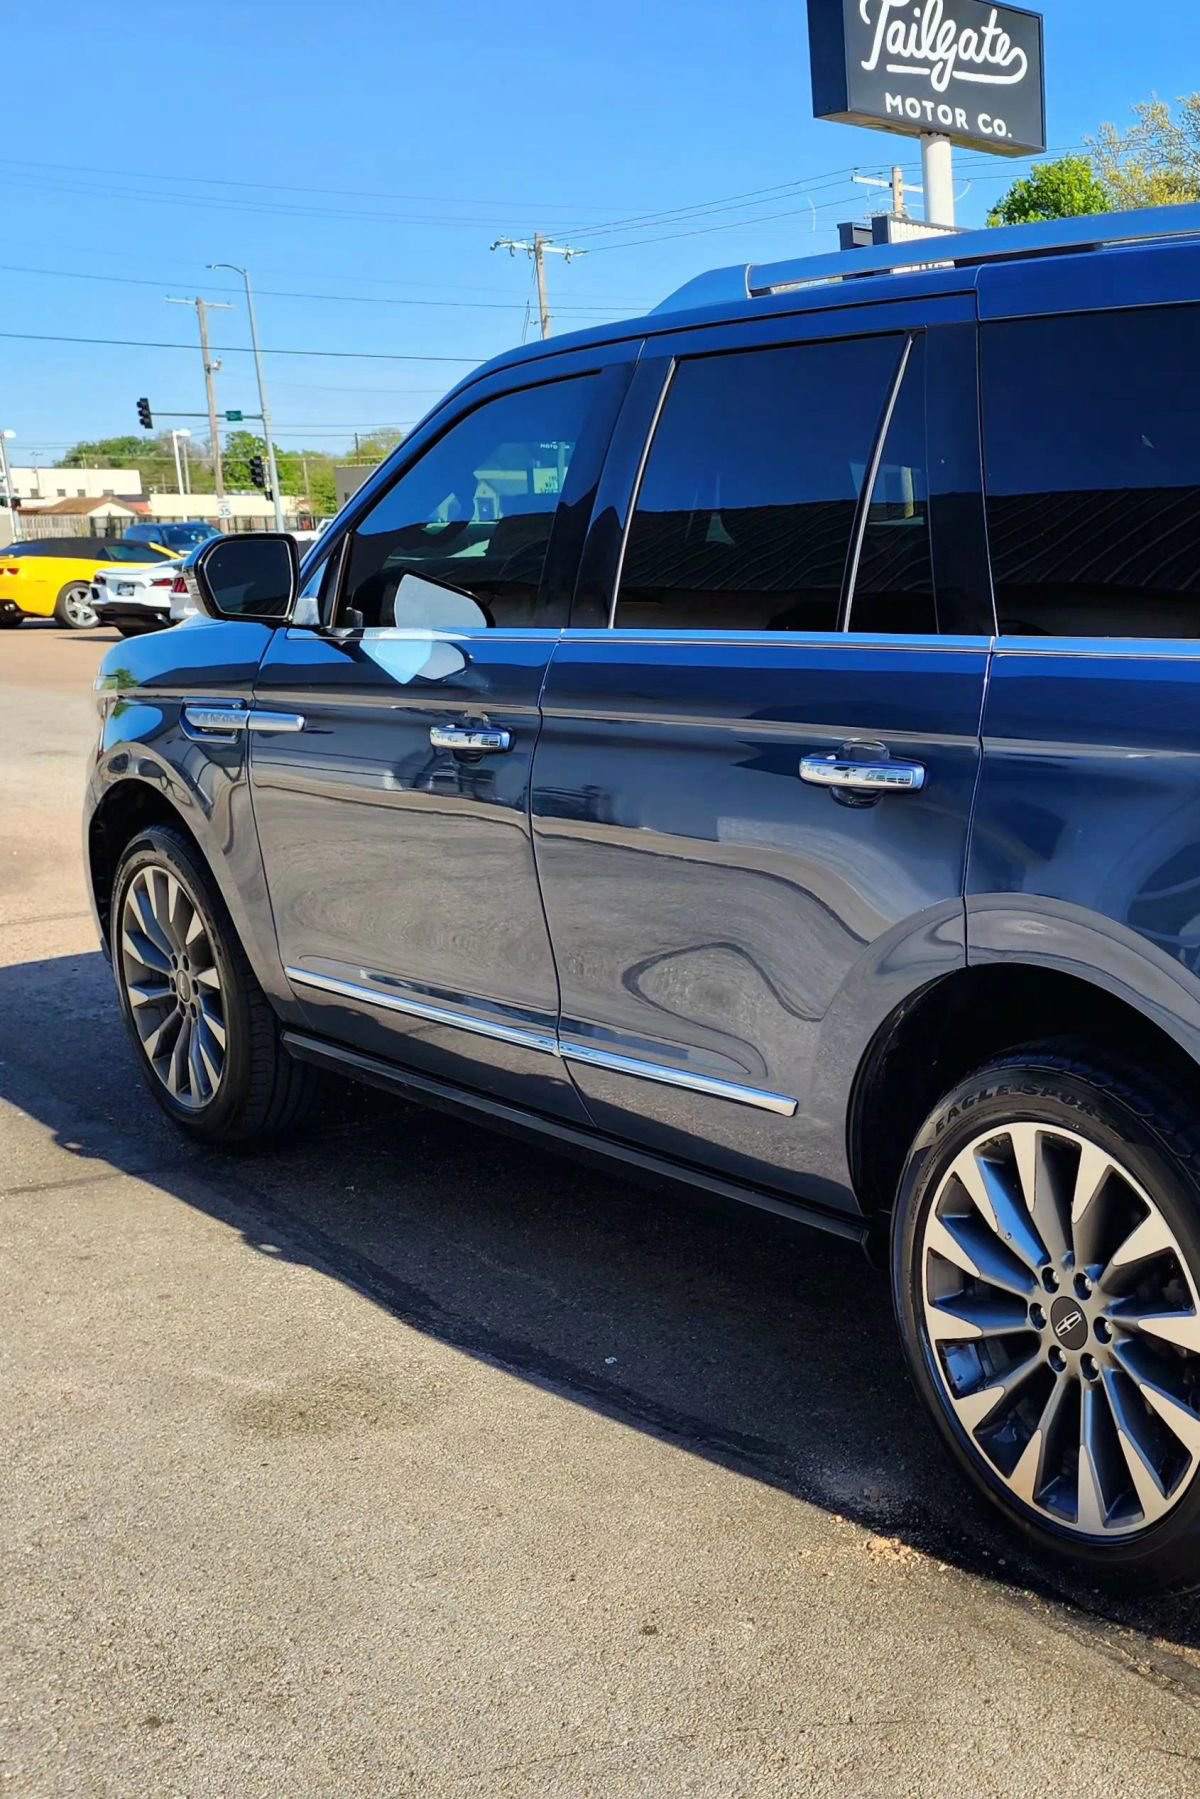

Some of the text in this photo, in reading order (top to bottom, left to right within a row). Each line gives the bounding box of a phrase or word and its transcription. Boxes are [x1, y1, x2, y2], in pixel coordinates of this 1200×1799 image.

[859, 0, 1028, 92] Tailgate
[884, 92, 1013, 138] MOTOR CO.
[934, 1083, 1011, 1137] EAGLE
